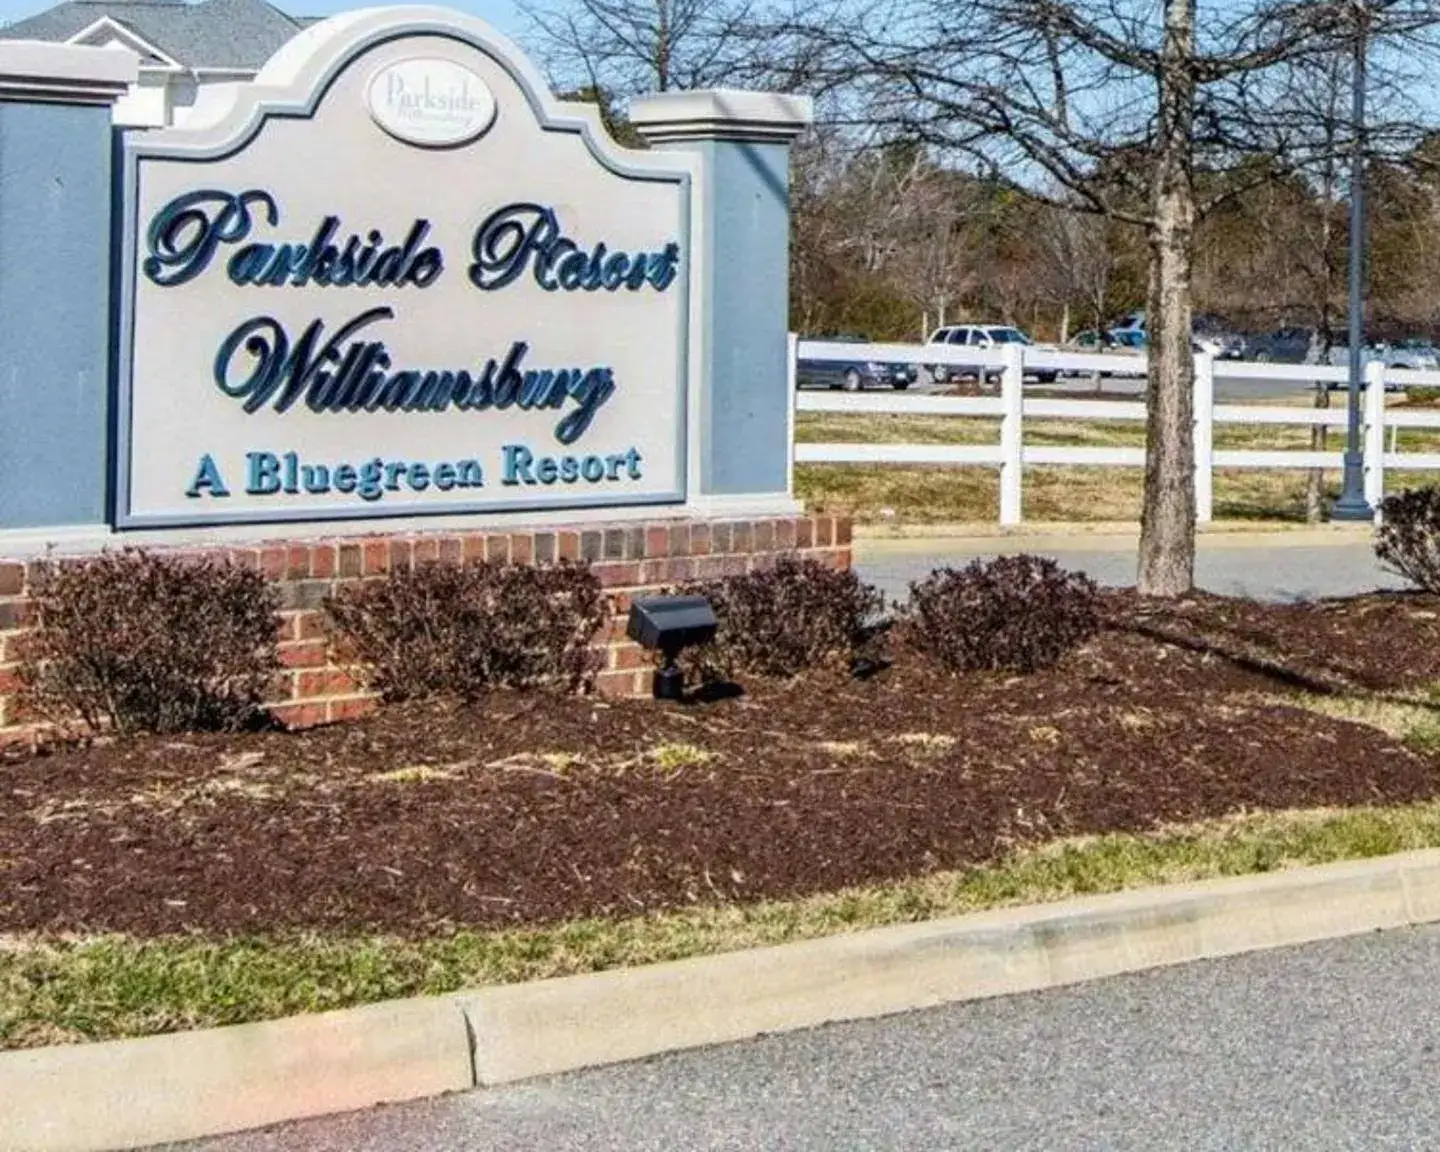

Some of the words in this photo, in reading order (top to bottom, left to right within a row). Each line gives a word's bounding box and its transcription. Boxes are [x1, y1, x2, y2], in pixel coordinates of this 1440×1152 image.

[143, 188, 445, 290] Parkside
[467, 201, 680, 293] Resort
[213, 305, 616, 445] Williamsburg
[184, 453, 231, 499] A
[245, 450, 484, 503] Bluegreen
[501, 445, 643, 487] Resort
